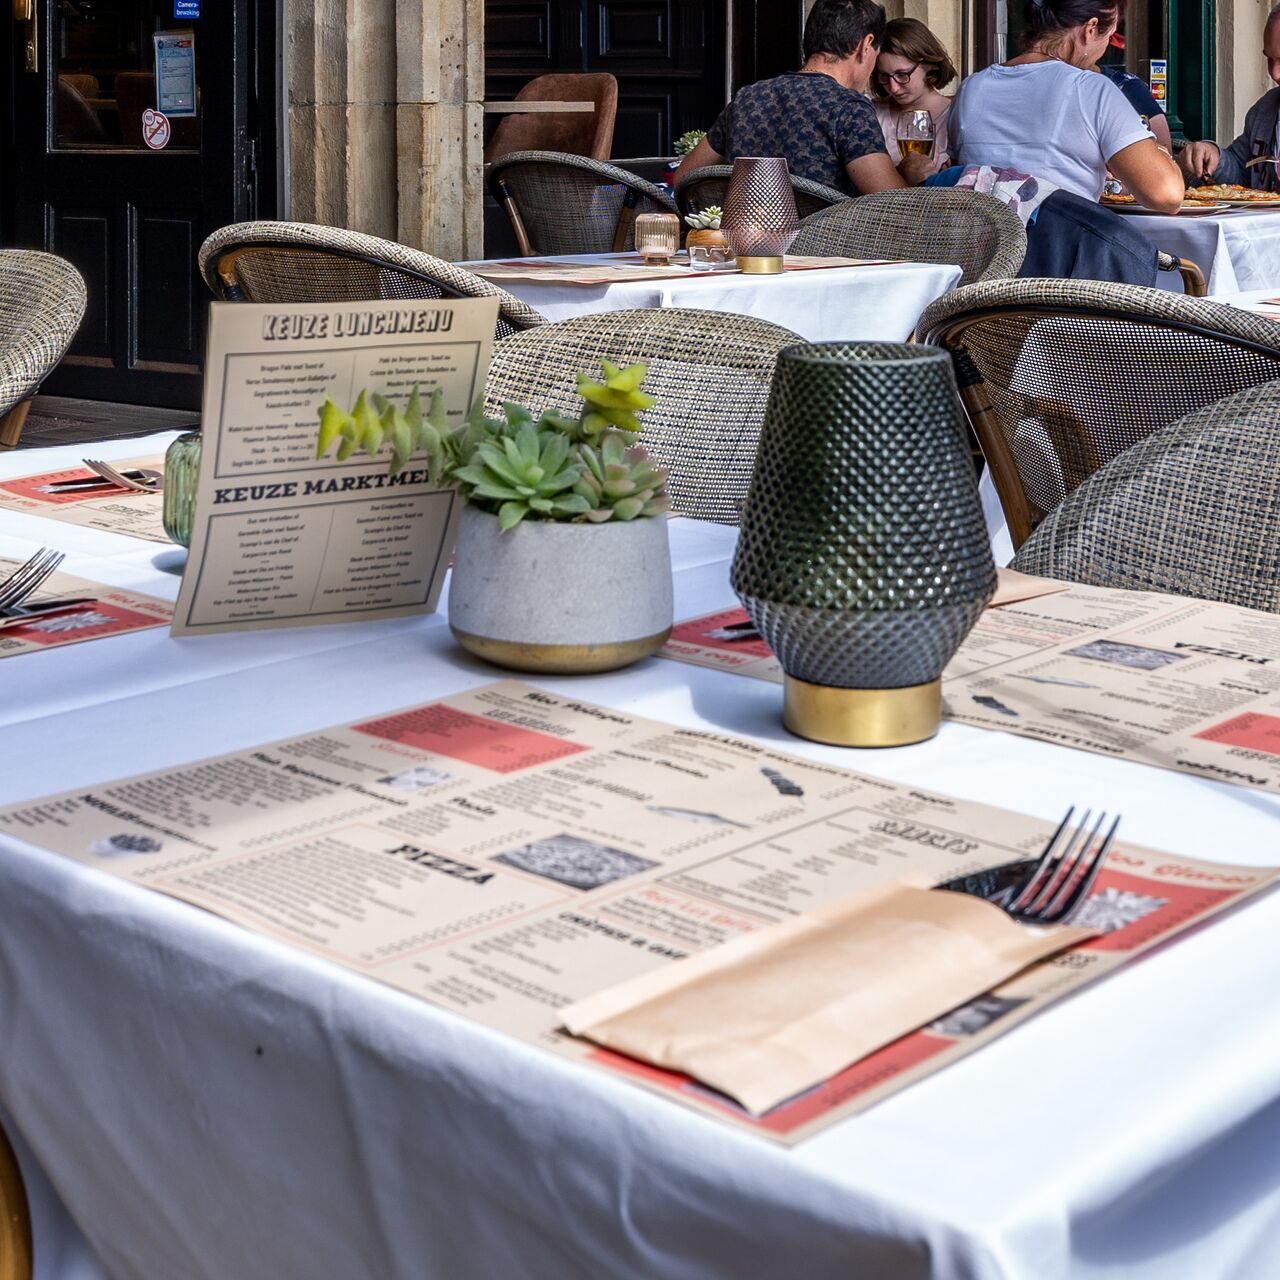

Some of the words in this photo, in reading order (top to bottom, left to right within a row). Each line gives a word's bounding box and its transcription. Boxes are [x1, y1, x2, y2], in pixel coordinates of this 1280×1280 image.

[263, 314, 329, 340] KEUZE
[333, 310, 453, 338] LUNCHMENU
[213, 482, 297, 504] KEUZE
[303, 470, 429, 495] MARKTME
[1173, 640, 1275, 665] PIZZA
[383, 842, 497, 887] PIZZA
